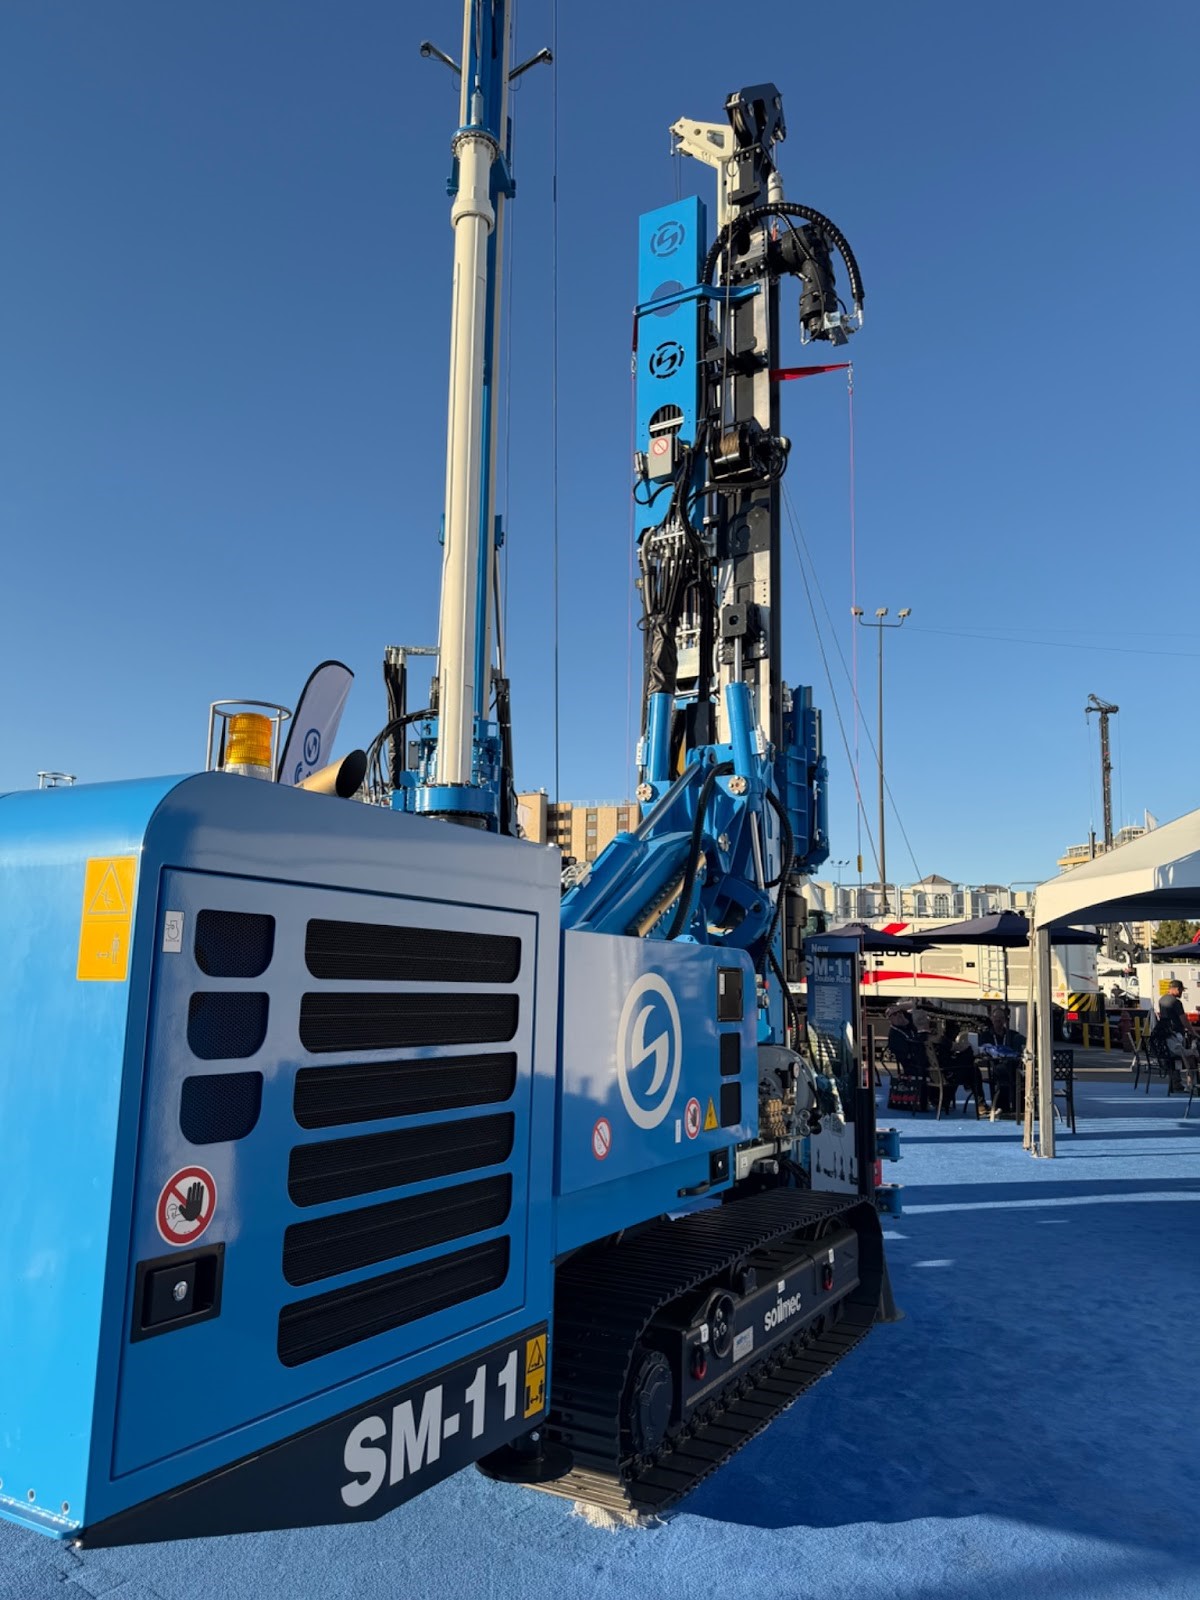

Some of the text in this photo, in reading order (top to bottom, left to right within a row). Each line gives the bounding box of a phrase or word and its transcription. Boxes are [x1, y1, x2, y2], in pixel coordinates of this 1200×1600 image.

[811, 943, 829, 952] New
[805, 955, 851, 977] SM-11
[764, 1293, 801, 1331] soilmec
[340, 1349, 518, 1507] SM-11
